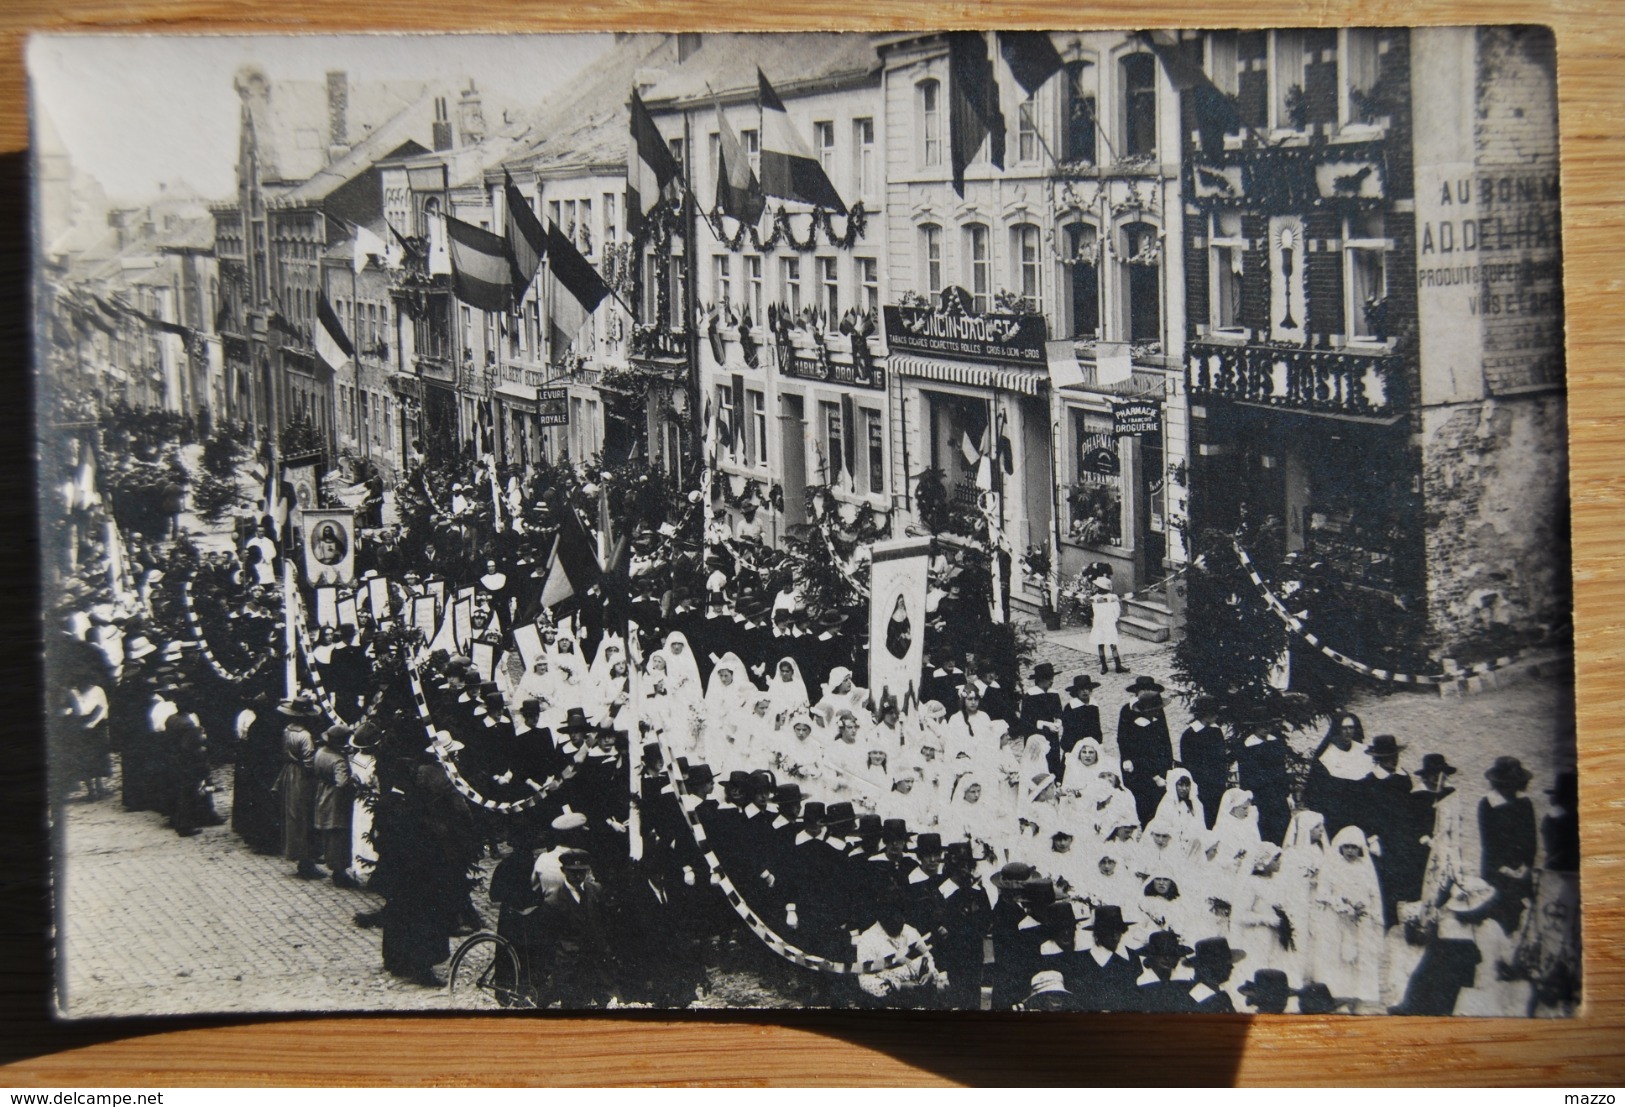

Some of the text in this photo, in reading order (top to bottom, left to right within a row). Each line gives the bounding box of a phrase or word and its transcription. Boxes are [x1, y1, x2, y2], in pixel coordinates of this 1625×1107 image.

[1440, 179, 1471, 206] AU
[1480, 177, 1531, 203] BON
[1419, 264, 1478, 289] PRODUITS
[1468, 294, 1502, 316] VINS
[889, 334, 907, 344] TABACS
[539, 389, 566, 400] LEVURE
[540, 414, 567, 425] ROYALE
[1115, 406, 1158, 420] PHARMACIE
[1115, 422, 1158, 433] DROGUERIE
[1081, 433, 1118, 461] PHARMAC
